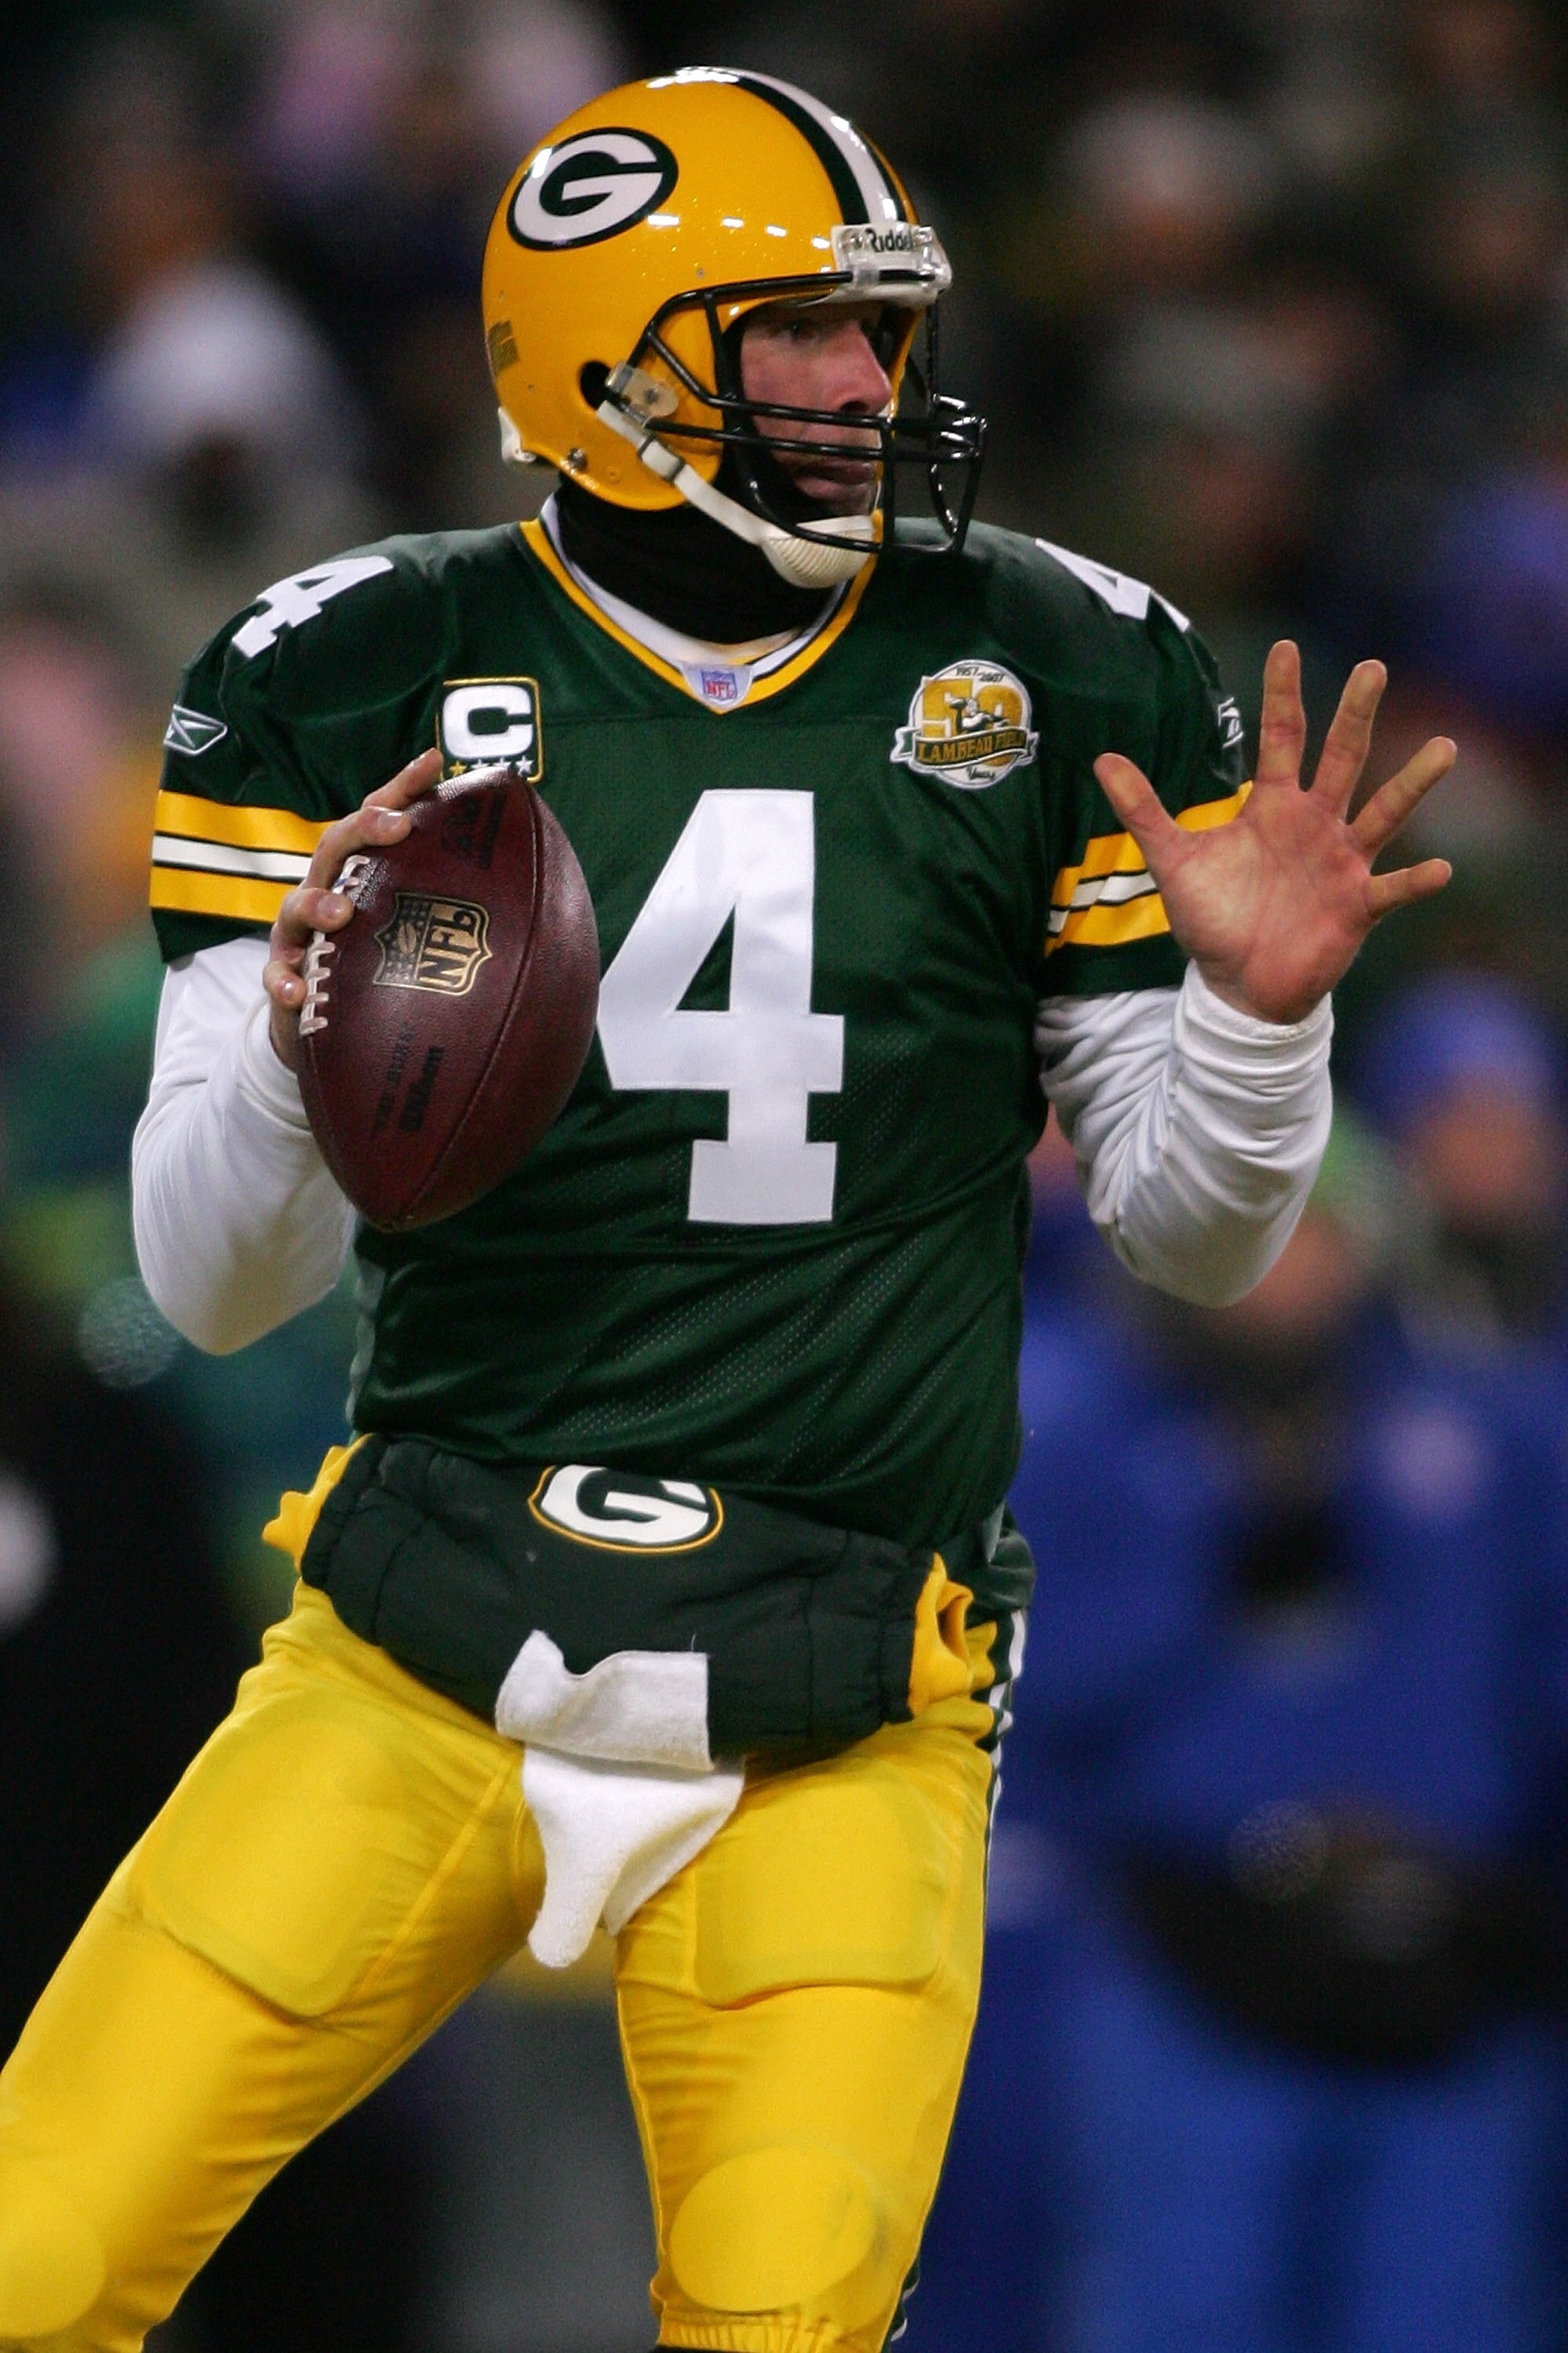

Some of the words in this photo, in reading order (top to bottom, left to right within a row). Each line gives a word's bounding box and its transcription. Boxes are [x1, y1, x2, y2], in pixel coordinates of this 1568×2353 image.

[514, 133, 664, 242] G
[232, 555, 393, 658] 4
[1035, 537, 1191, 633] 4
[442, 685, 533, 759] C
[917, 735, 993, 762] LAMBEAU
[417, 903, 479, 990] NFL
[596, 788, 845, 1224] 4
[540, 1464, 709, 1544] G
